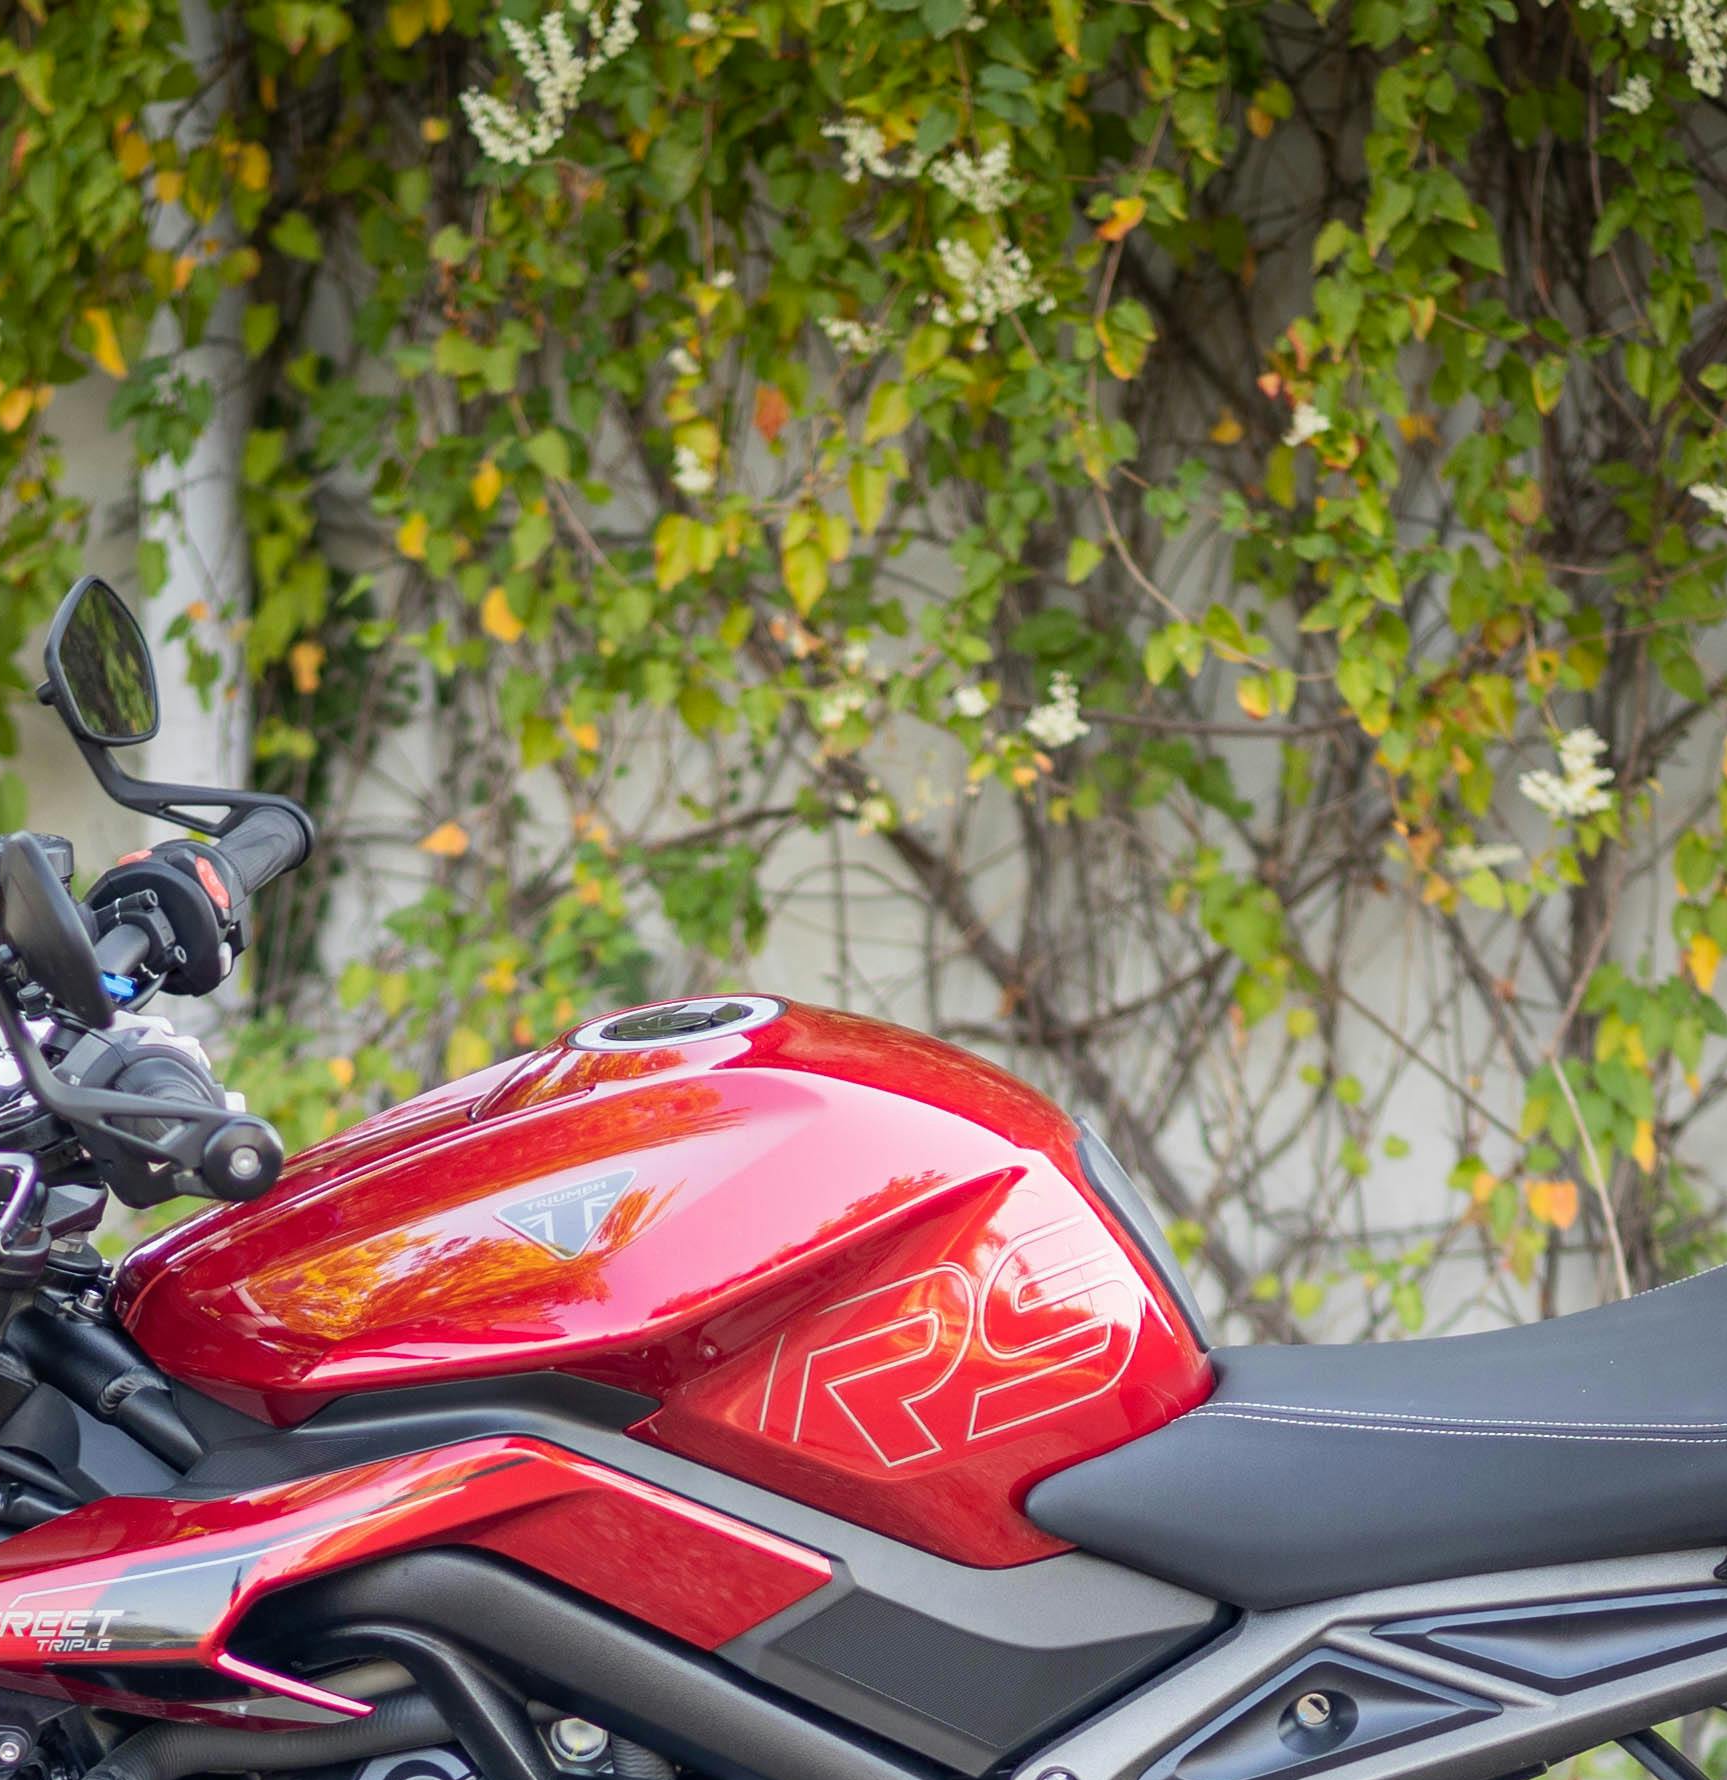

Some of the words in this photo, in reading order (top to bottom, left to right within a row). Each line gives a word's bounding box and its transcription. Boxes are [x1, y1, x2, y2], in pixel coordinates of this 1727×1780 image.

[525, 1181, 608, 1212] TRIUMPH
[759, 1215, 1145, 1467] RS
[36, 1639, 112, 1653] TRIPLE
